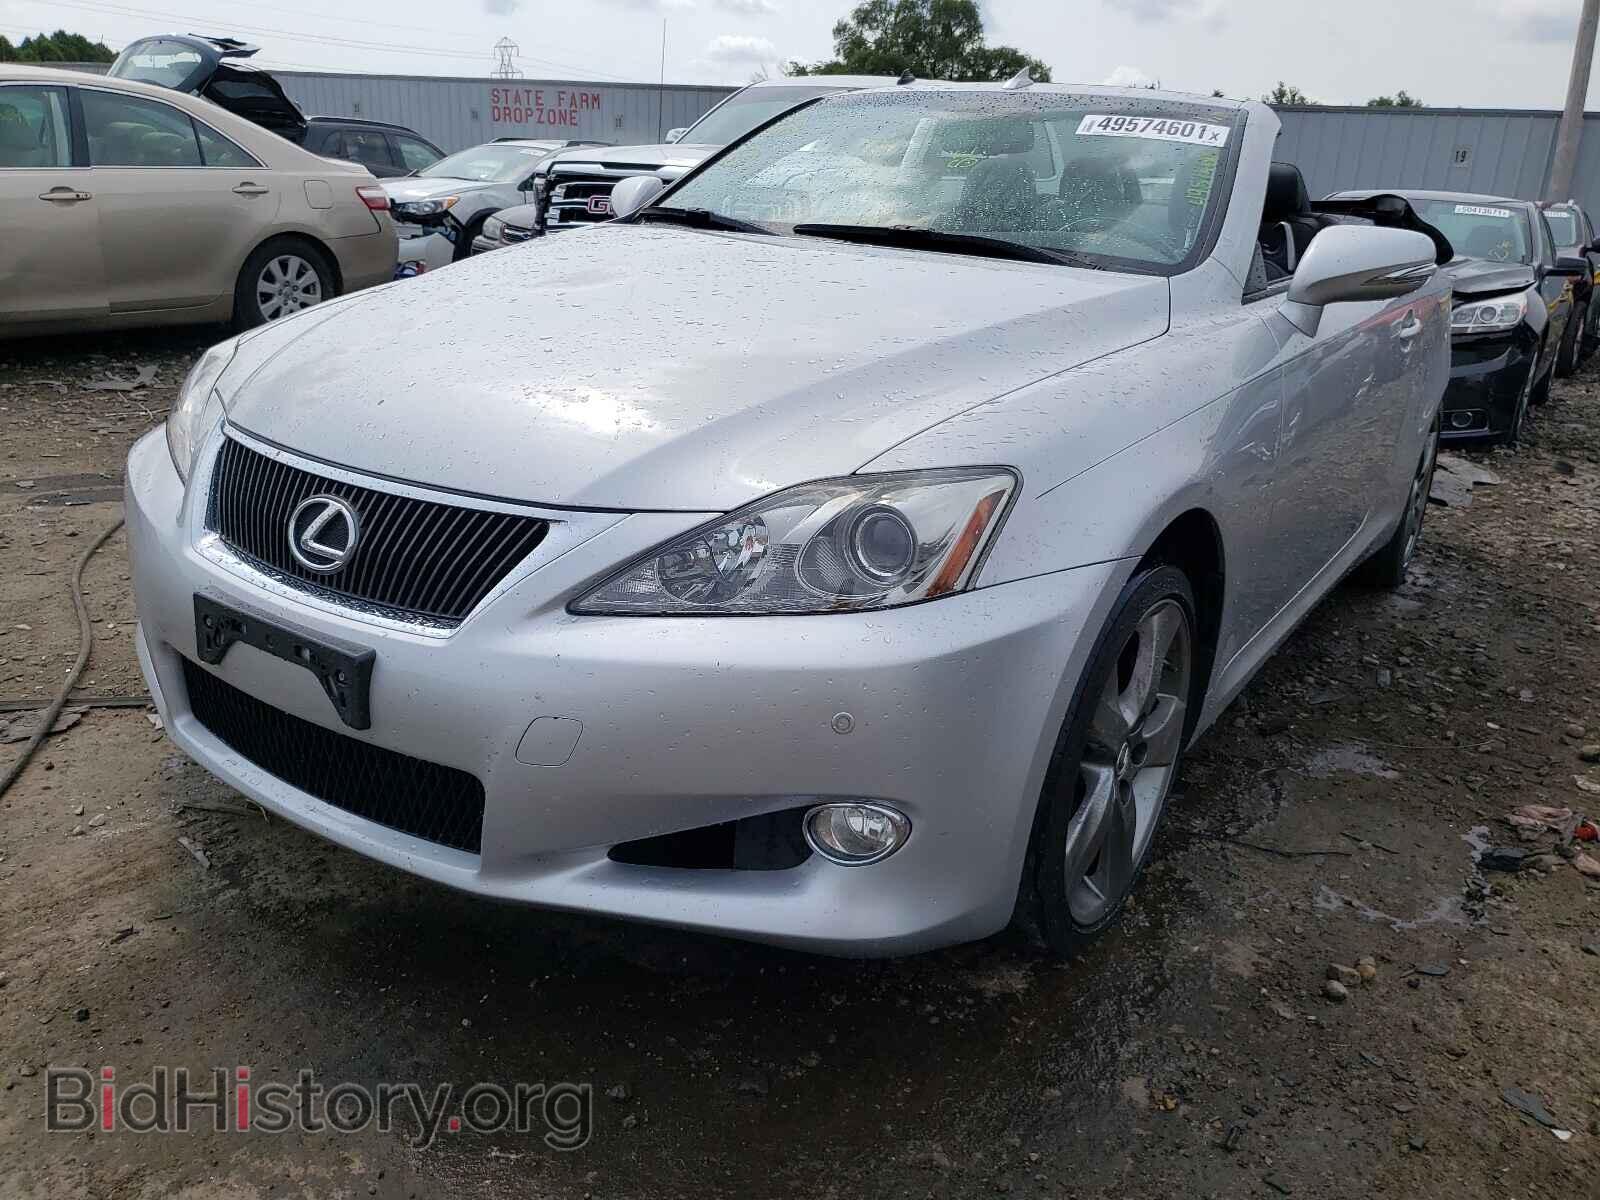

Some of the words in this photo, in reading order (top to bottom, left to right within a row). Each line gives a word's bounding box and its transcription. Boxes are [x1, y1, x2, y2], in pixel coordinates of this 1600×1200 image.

[491, 88, 544, 107] STATE
[557, 91, 600, 111] FARM
[492, 106, 578, 126] DROPZONE
